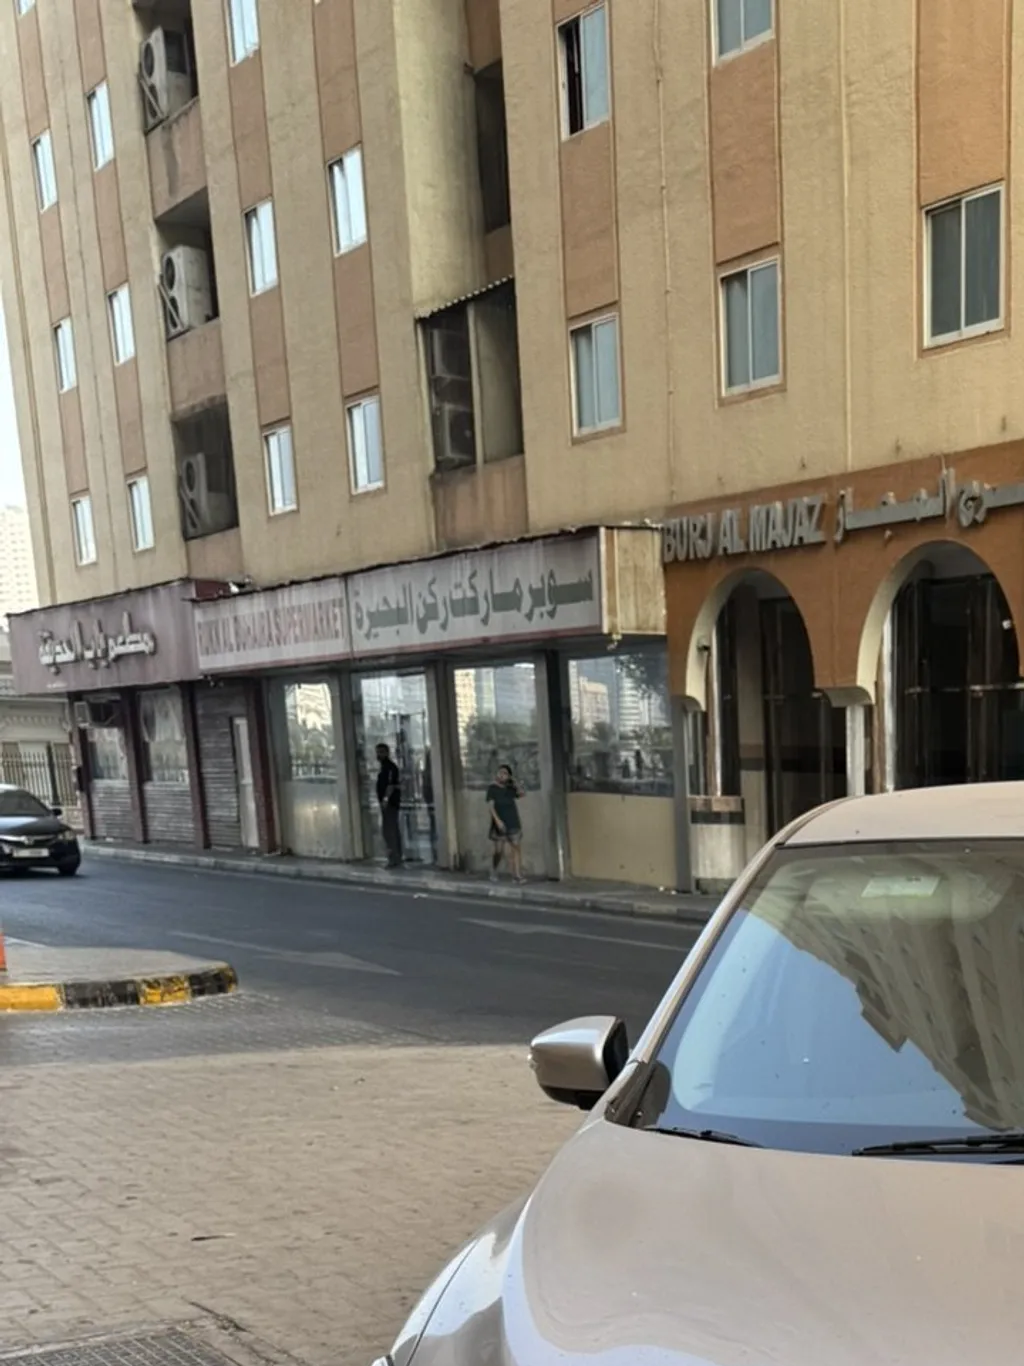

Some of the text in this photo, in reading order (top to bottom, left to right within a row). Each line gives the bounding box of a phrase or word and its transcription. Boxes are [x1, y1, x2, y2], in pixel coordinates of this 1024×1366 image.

[664, 494, 826, 563] BURJ AL MAJAZ
